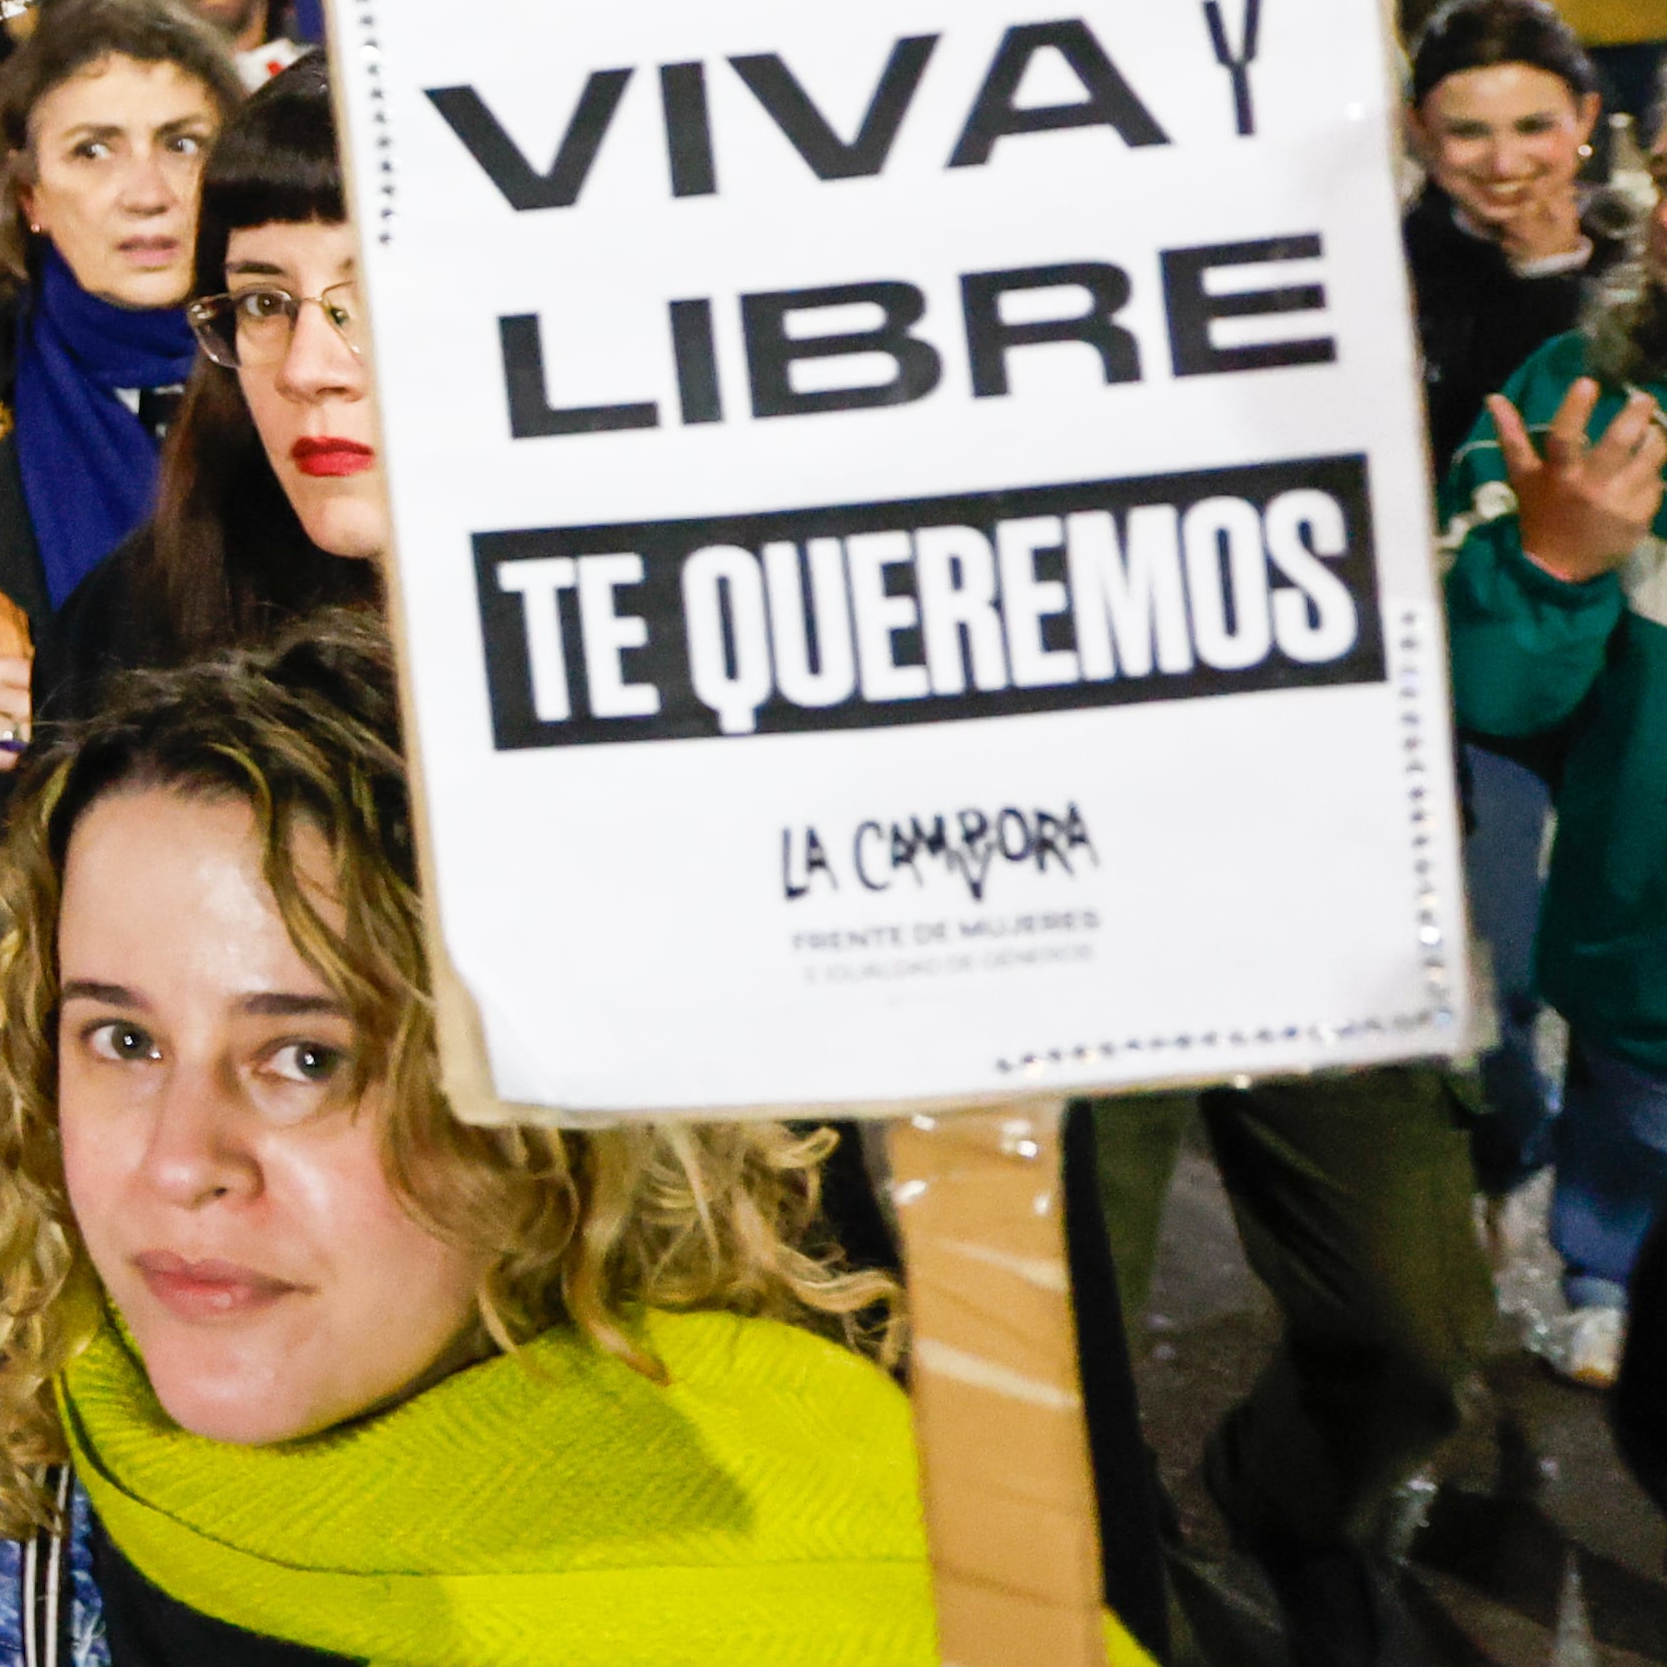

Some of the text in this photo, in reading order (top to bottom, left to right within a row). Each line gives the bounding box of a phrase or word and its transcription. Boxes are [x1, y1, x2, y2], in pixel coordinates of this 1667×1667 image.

[422, 16, 1173, 212] VIVA
[497, 232, 1338, 441] LIBRE
[496, 487, 1359, 735] TE QUEREMOS
[781, 824, 838, 900] LA
[792, 907, 1101, 952] FRENTE DE MUJERES
